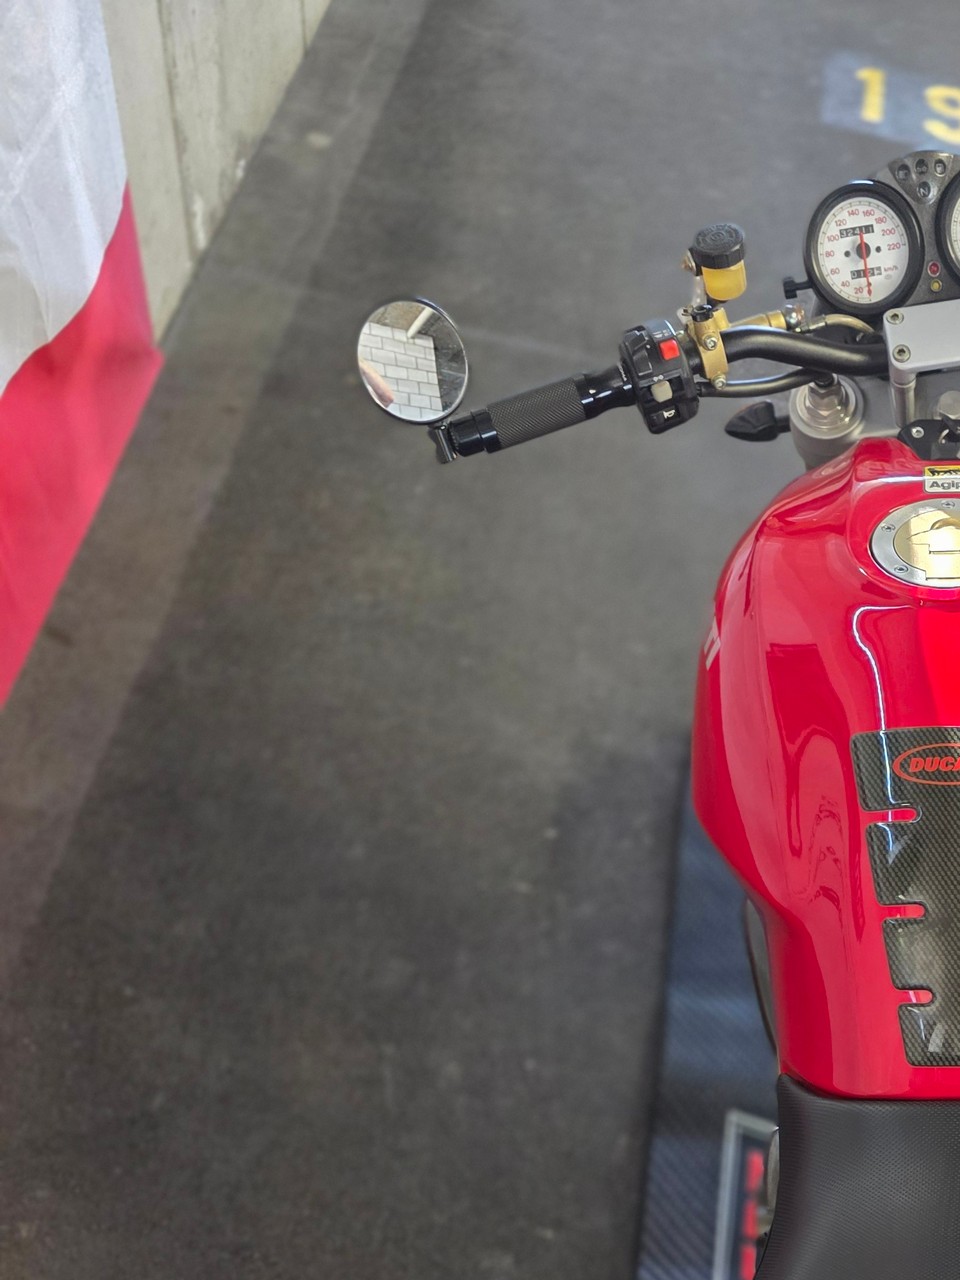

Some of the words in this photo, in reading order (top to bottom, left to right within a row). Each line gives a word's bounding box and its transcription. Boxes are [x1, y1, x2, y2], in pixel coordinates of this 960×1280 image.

[847, 208, 860, 217] 140
[862, 209, 875, 218] 160
[834, 218, 847, 227] 120
[874, 216, 887, 225] 180
[881, 227, 896, 236] 200
[826, 233, 840, 242] 100
[887, 242, 901, 251] 220
[825, 249, 835, 258] 80
[830, 267, 840, 276] 60
[840, 280, 850, 288] 40
[854, 286, 864, 295] 20
